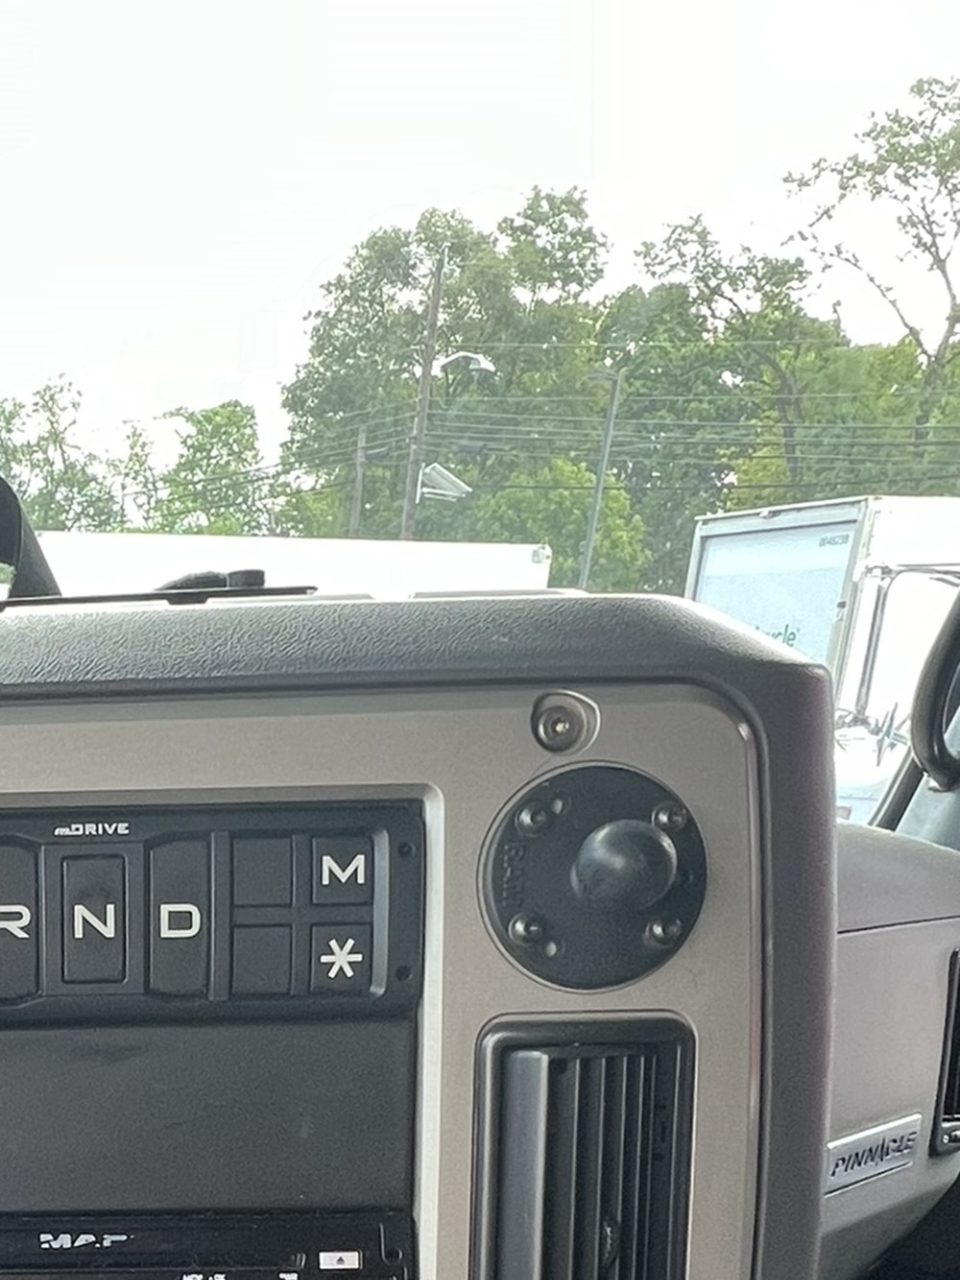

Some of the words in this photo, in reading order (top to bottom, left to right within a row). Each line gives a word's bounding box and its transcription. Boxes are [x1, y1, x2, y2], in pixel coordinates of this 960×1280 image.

[54, 822, 130, 836] mDRIVE
[321, 854, 366, 885] M
[74, 904, 116, 939] N
[160, 903, 201, 938] D
[830, 1131, 917, 1177] PINNACLE
